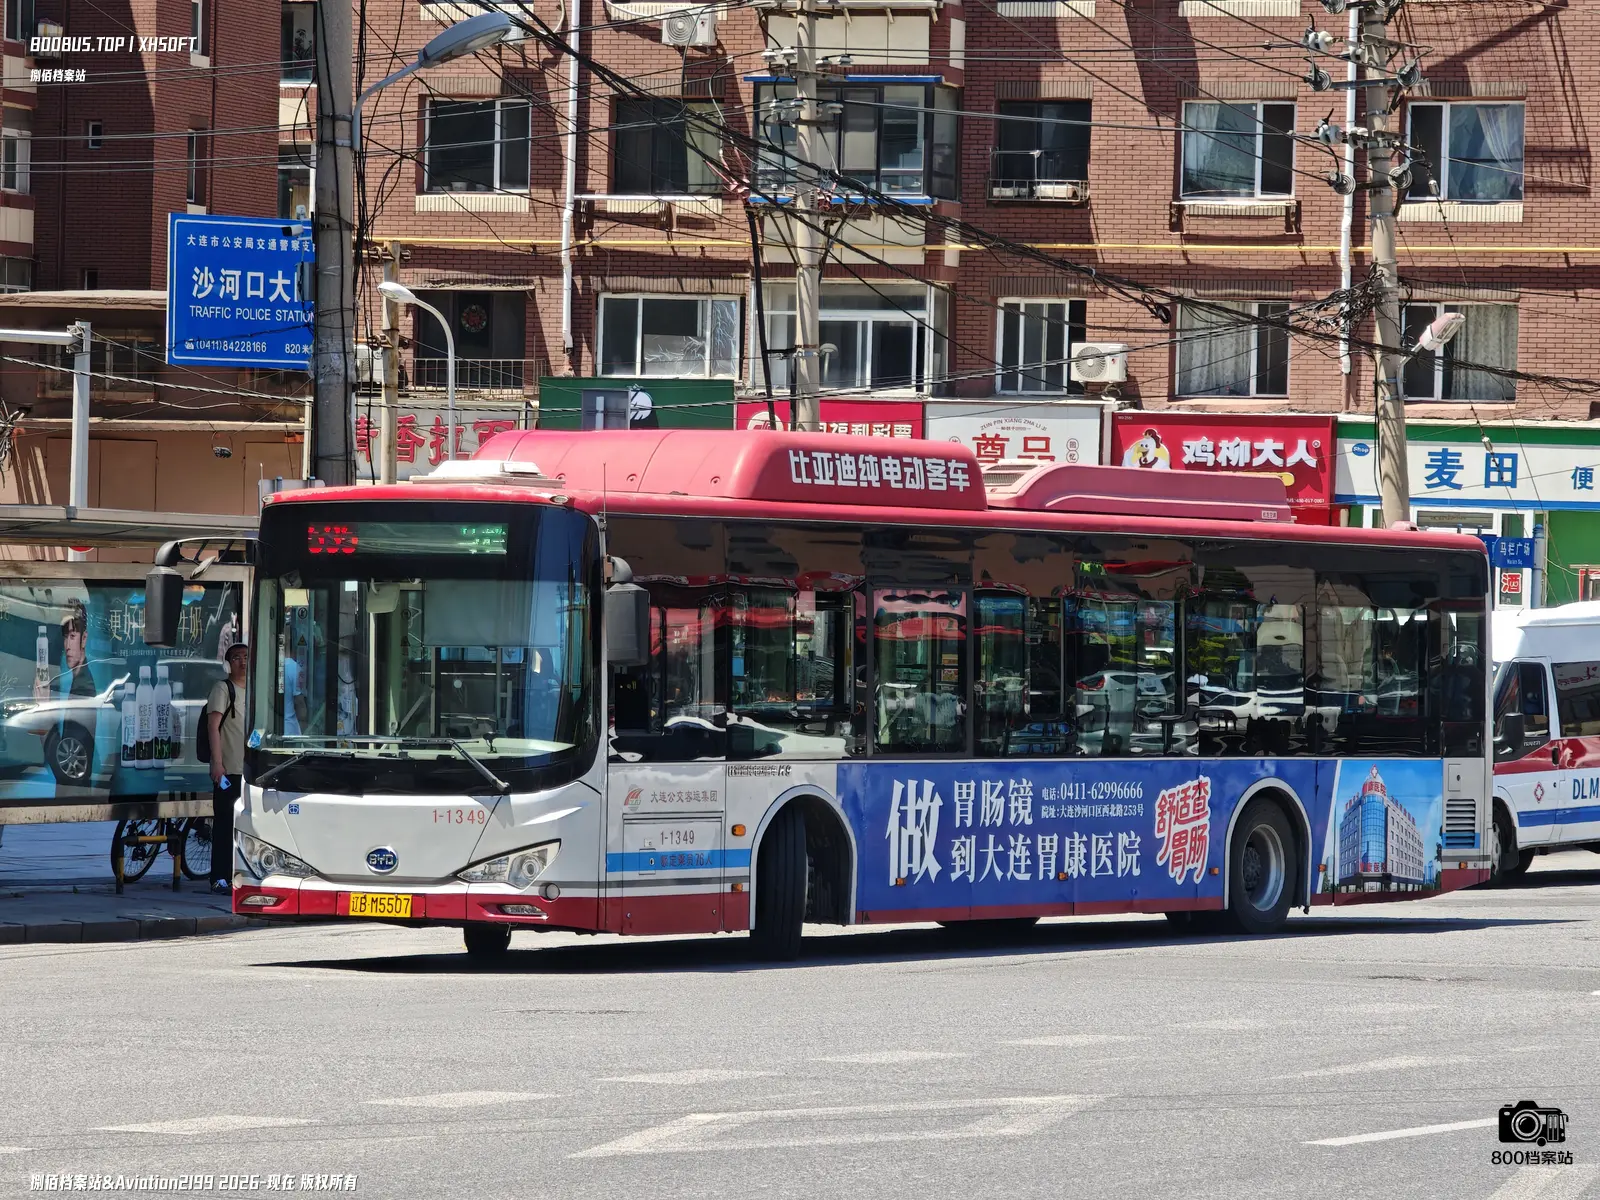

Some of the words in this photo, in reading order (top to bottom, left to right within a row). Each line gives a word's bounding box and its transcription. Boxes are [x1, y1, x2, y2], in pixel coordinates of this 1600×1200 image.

[187, 234, 315, 252] 大连市公安局交通警察支
[192, 266, 298, 303] 沙河口大
[189, 305, 232, 319] TRAFFIC
[235, 307, 271, 321] POLICE
[1181, 436, 1317, 468] 鸡柳大人
[788, 448, 971, 493] 比亚迪纯电动客车
[1424, 448, 1518, 490] 麦田
[1571, 465, 1594, 490] 便
[1500, 542, 1531, 556] 马栏广场
[1501, 573, 1521, 593] 酒
[650, 790, 718, 803] 大连公交客运集团
[953, 778, 1034, 828] 胃肠镜
[432, 809, 486, 824] 1-1349
[660, 830, 695, 846] 1-1349
[885, 778, 943, 887] 做
[369, 853, 394, 865] BYD
[950, 830, 1142, 883] 到大连胃康医院
